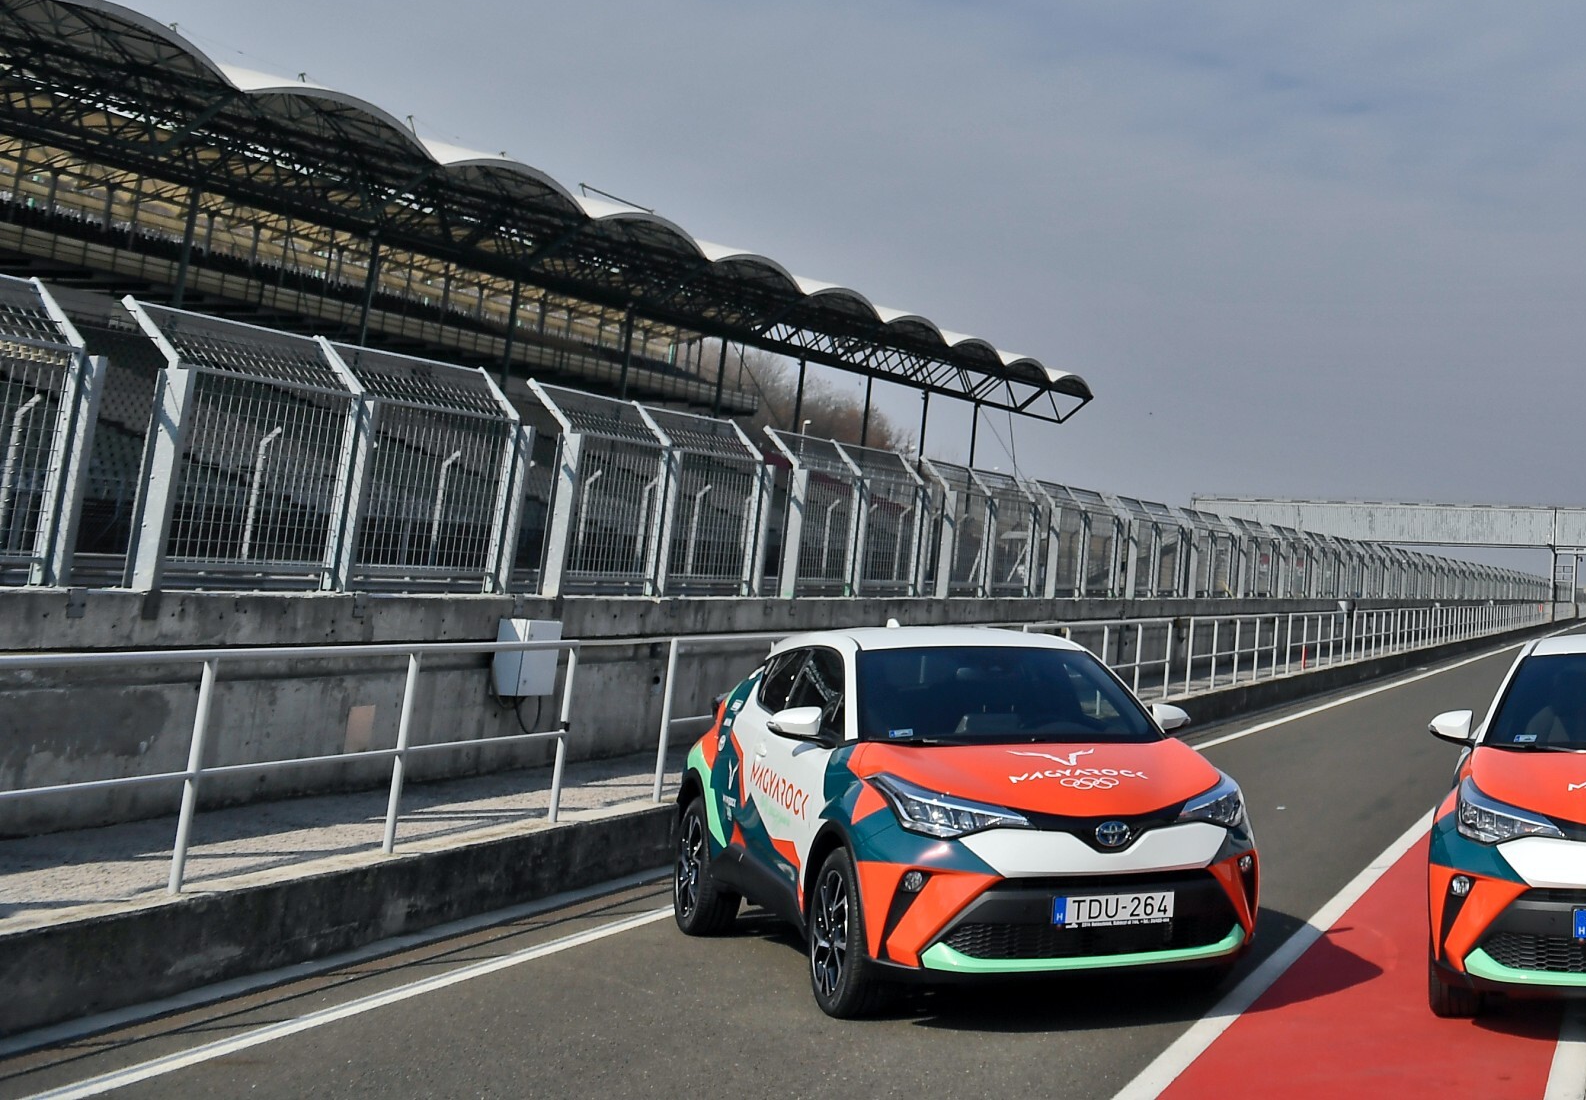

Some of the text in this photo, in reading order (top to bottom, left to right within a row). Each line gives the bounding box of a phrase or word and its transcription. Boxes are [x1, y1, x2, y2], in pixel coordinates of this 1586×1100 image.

[1072, 895, 1168, 920] TDU-264
[1056, 913, 1063, 921] H
[1578, 926, 1586, 935] H
